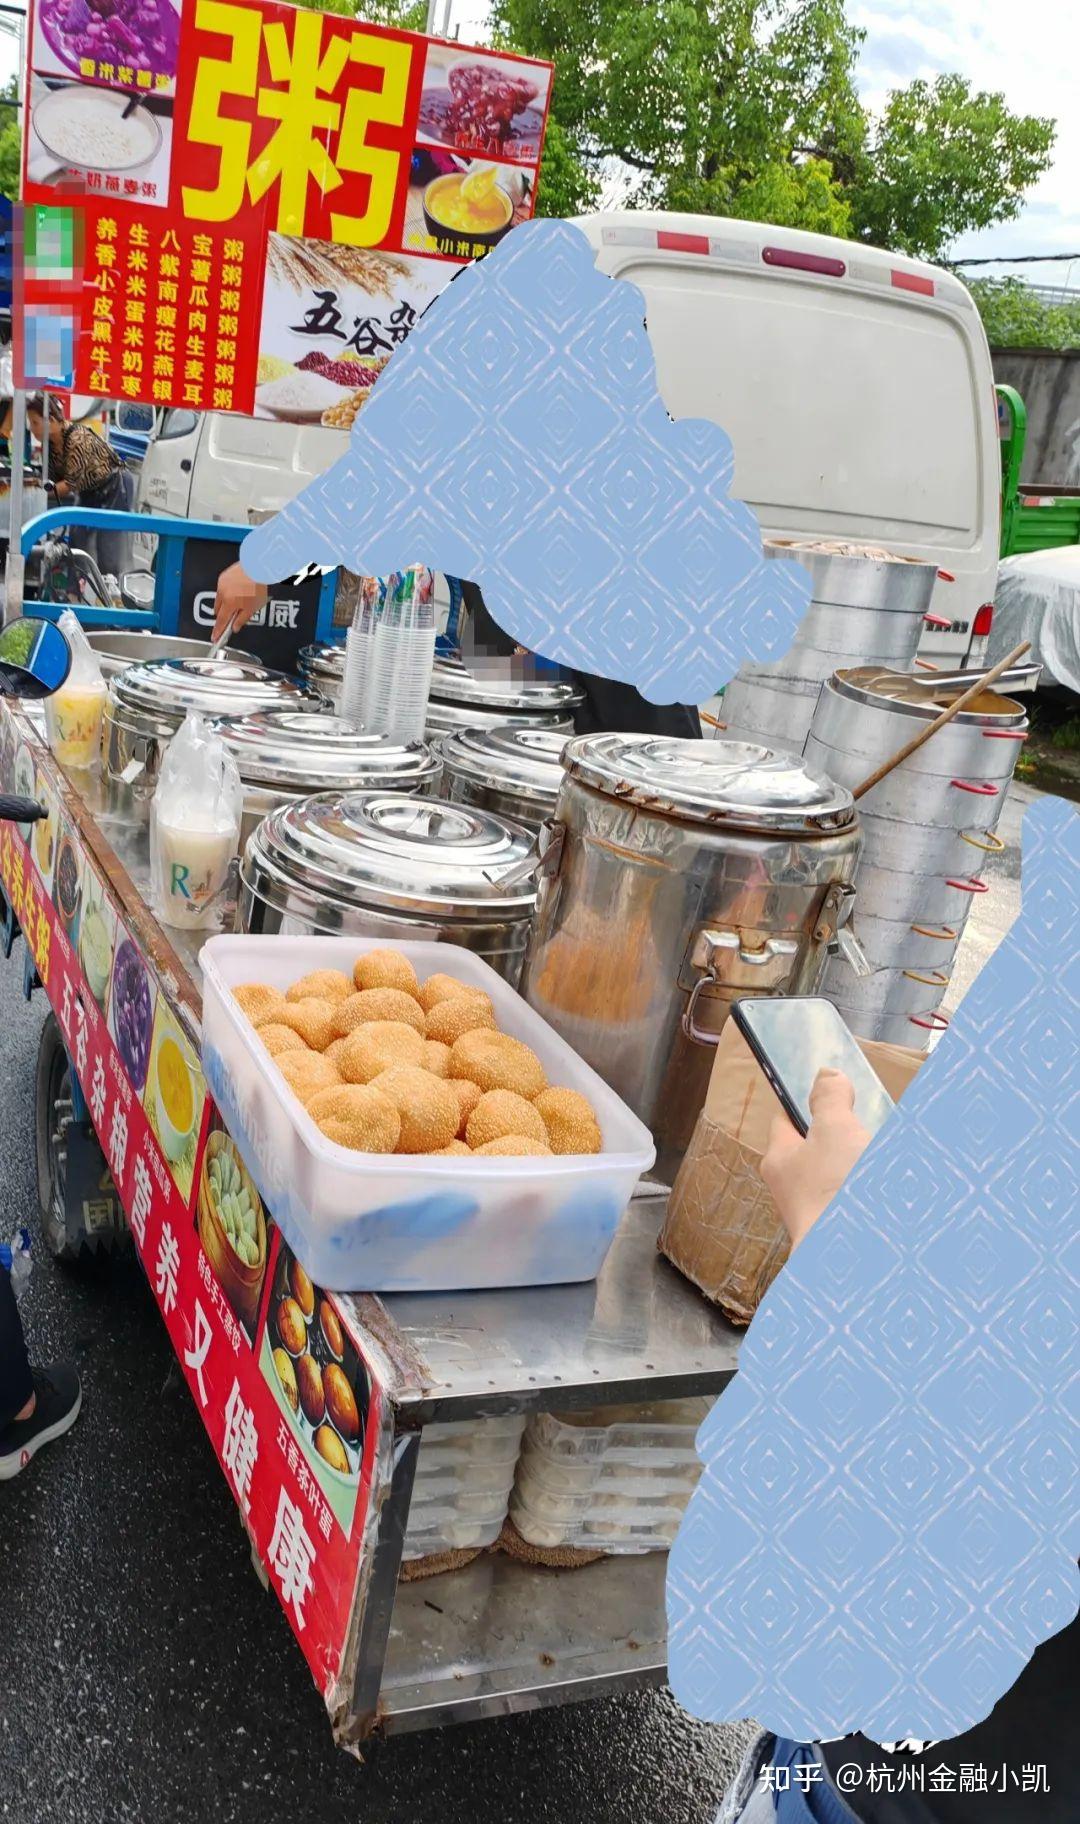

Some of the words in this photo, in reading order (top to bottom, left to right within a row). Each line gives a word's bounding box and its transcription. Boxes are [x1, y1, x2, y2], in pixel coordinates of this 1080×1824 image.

[182, 4, 413, 248] 粥
[96, 217, 244, 262] 养生八宝粥
[95, 243, 242, 287] 香米紫薯粥
[94, 270, 240, 312] 小米南瓜粥
[92, 296, 238, 337] 皮蛋瘦肉粥
[91, 321, 236, 361] 黑米花生粥
[90, 346, 235, 385] 牛奶燕麦粥
[89, 371, 233, 409] 红枣银耳粥
[276, 1417, 334, 1544] 五香茶叶蛋
